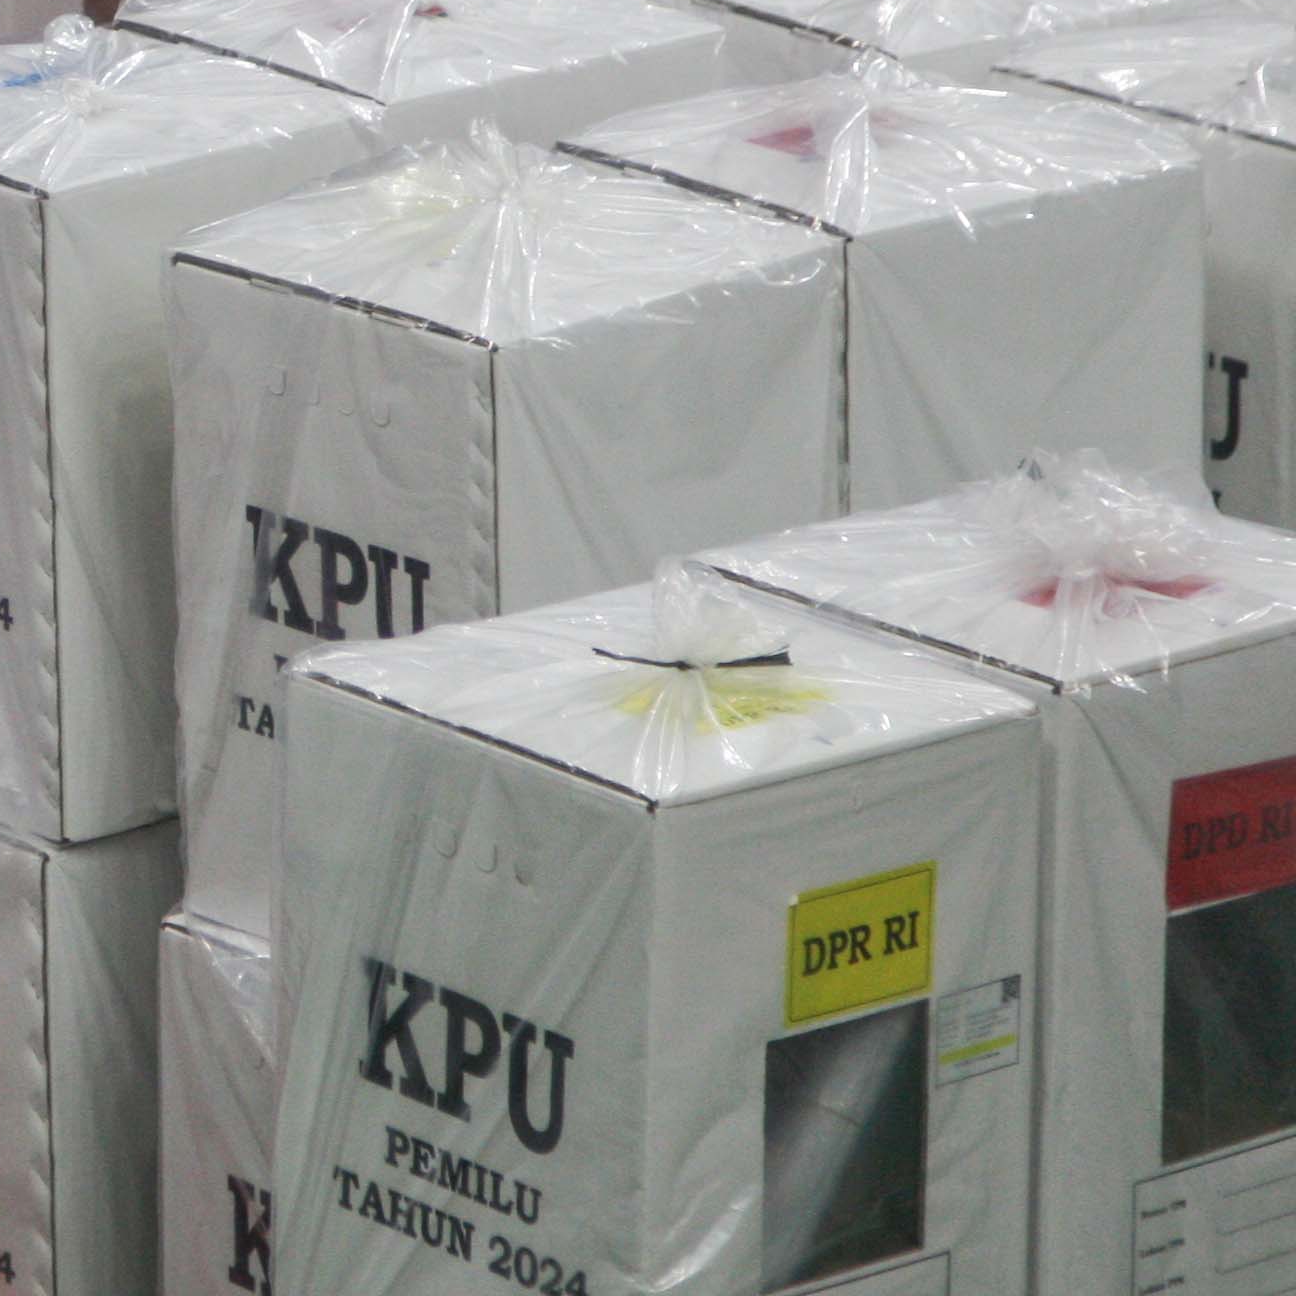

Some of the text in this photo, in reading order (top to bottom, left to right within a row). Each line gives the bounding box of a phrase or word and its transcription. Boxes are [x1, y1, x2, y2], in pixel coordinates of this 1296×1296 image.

[246, 505, 430, 641] KPU
[1181, 802, 1295, 861] DPD RI
[801, 910, 921, 978] DPR RI
[359, 956, 574, 1156] KPU
[333, 1165, 475, 1262] TAHUN
[488, 1235, 590, 1296] 2024
[384, 1125, 543, 1226] PEMILU
